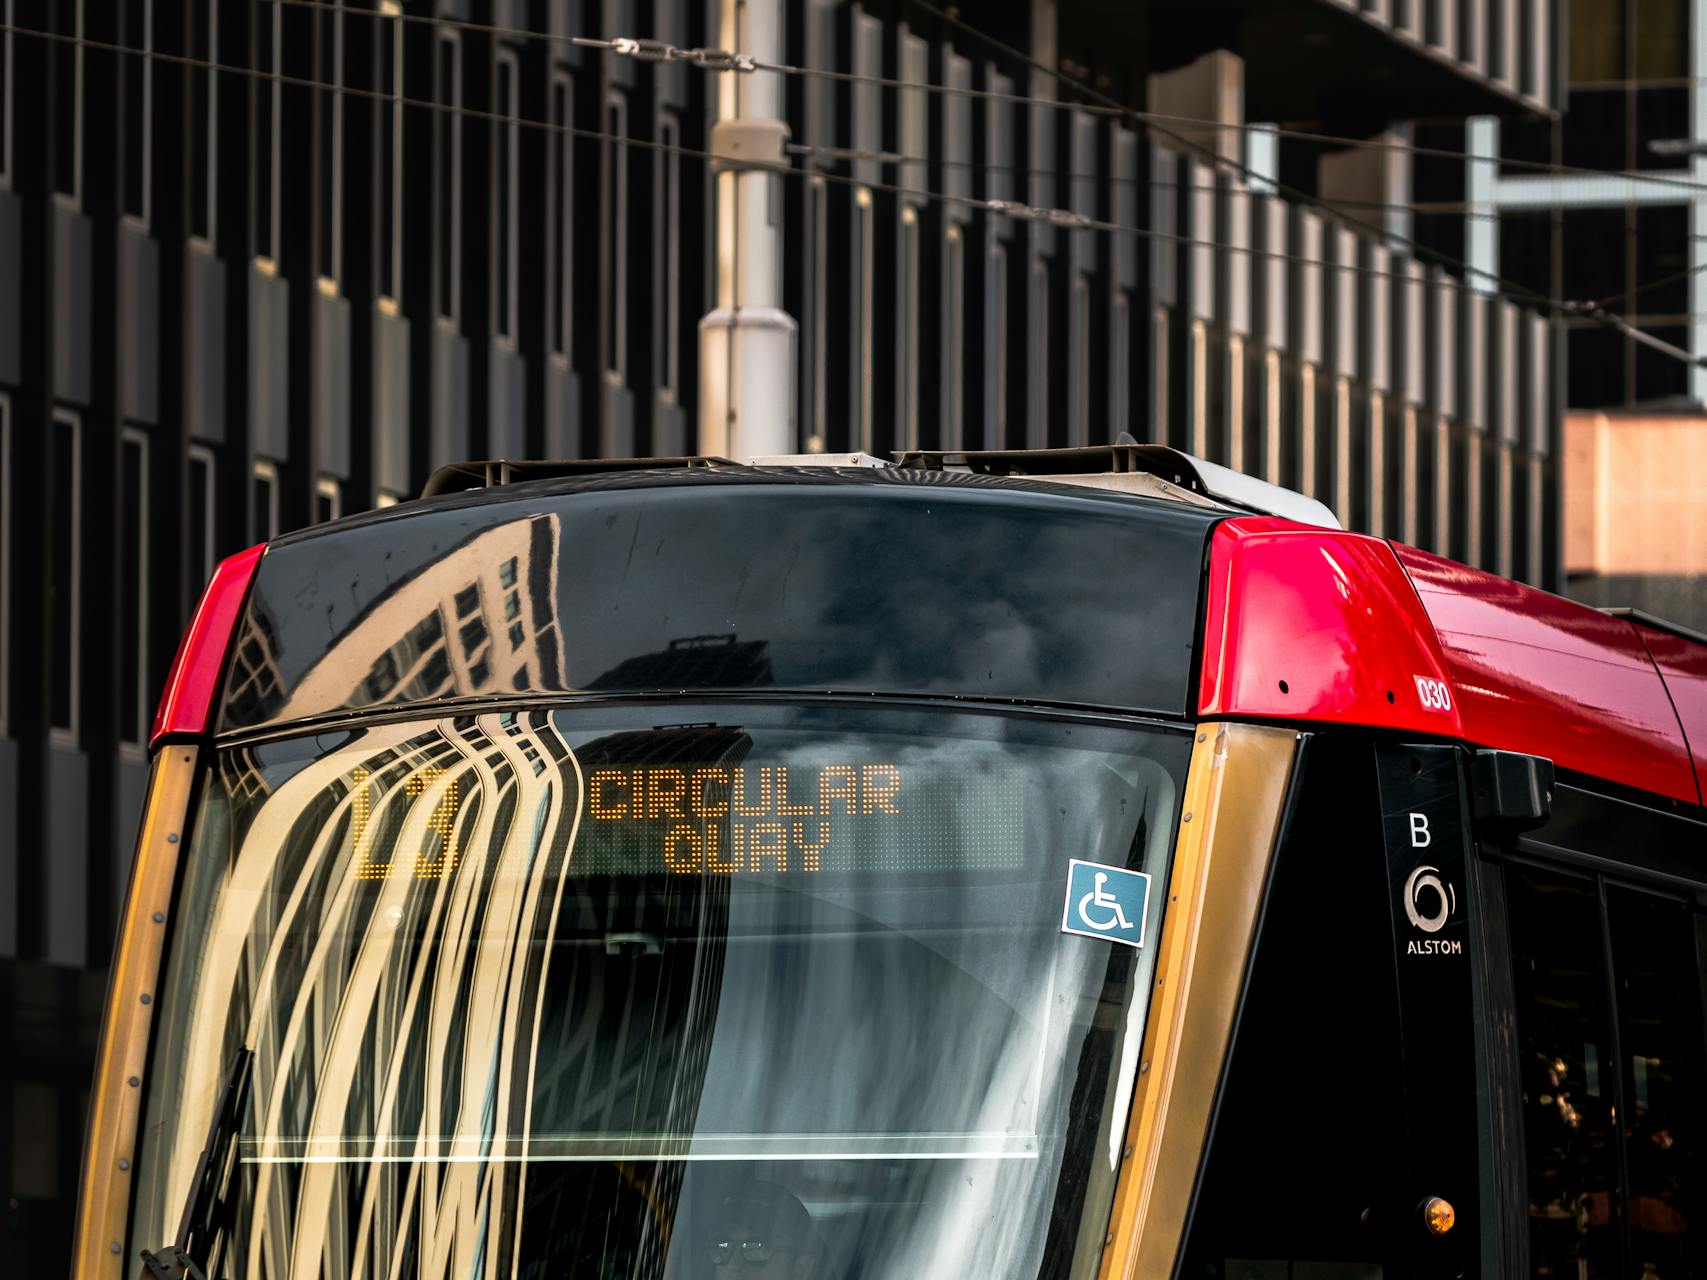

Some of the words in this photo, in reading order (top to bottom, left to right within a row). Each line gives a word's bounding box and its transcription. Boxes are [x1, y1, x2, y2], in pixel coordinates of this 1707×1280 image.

[1417, 678, 1451, 711] 030
[590, 764, 900, 820] CIRCULAR
[353, 768, 459, 880] L3
[1409, 812, 1431, 848] B
[664, 821, 830, 874] QUAY
[1407, 940, 1462, 955] ALSTOM
